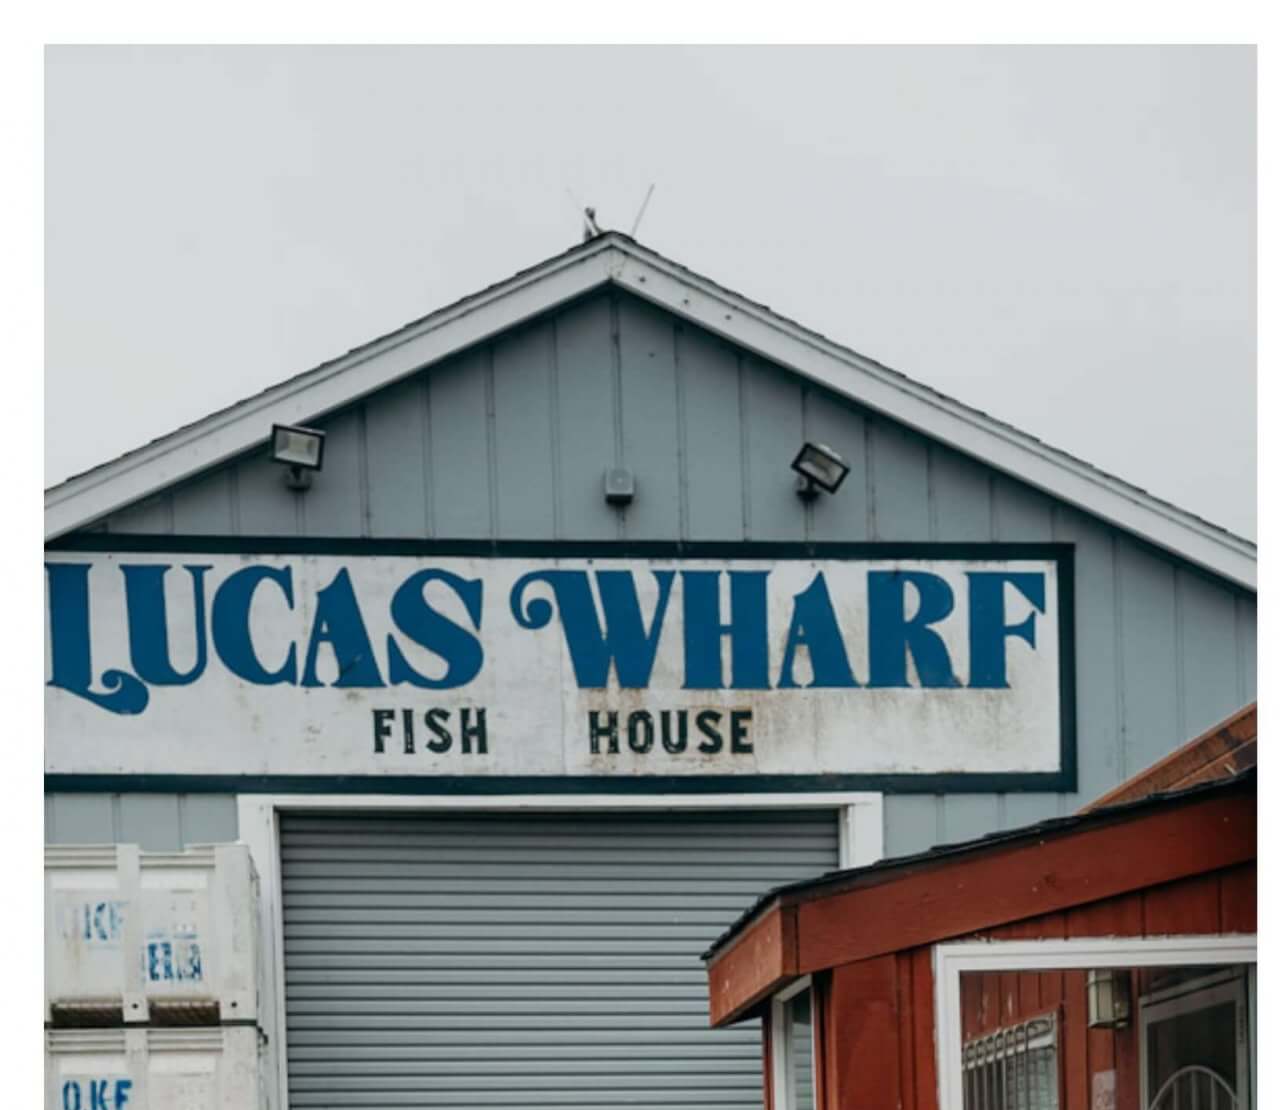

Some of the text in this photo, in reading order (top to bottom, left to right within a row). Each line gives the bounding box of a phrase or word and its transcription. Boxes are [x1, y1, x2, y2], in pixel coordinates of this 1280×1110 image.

[44, 562, 1045, 715] LUCAS WHARF
[372, 708, 754, 755] FISH HOUSE
